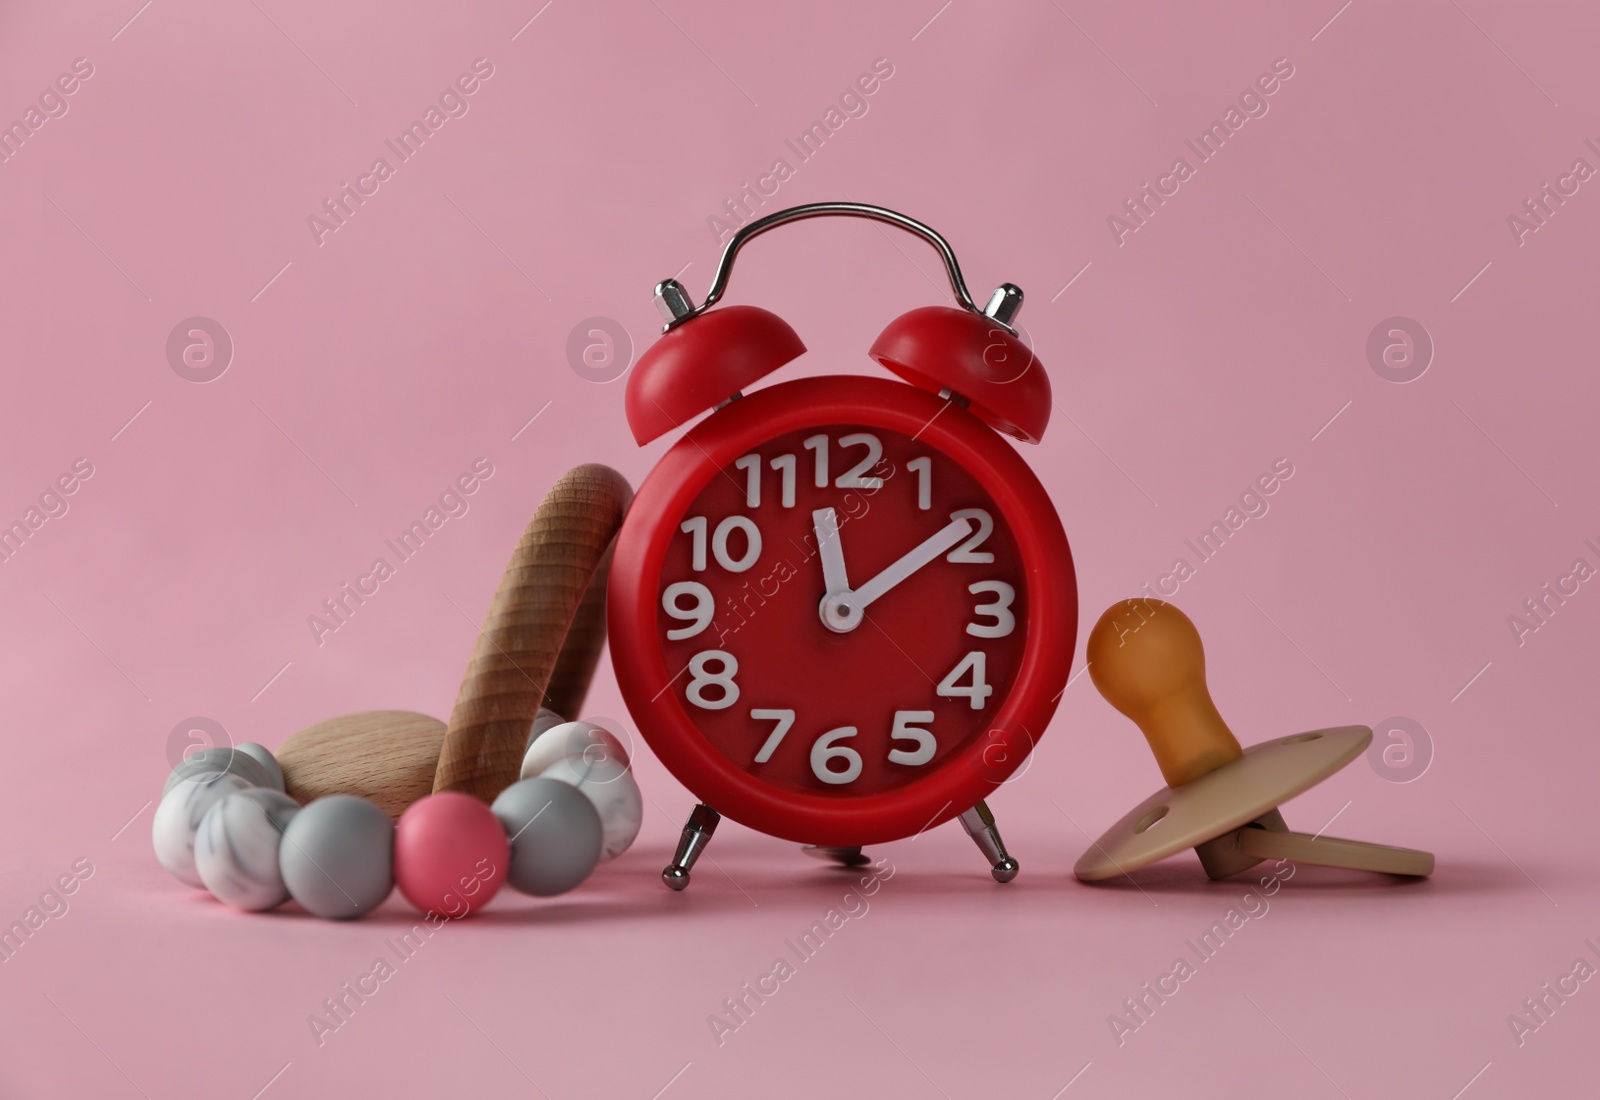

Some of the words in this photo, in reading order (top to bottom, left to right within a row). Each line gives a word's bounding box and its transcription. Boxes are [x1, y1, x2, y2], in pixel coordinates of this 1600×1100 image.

[735, 454, 796, 508] 11
[803, 433, 883, 488] 12
[906, 456, 932, 510] 1
[680, 515, 762, 573] 10
[946, 507, 995, 564] 2
[662, 581, 715, 641] 9
[965, 580, 1015, 638] 3
[685, 650, 740, 710] 8
[936, 651, 993, 710] 4
[750, 709, 796, 763] 7
[810, 726, 863, 784] 6
[887, 710, 937, 766] 5
